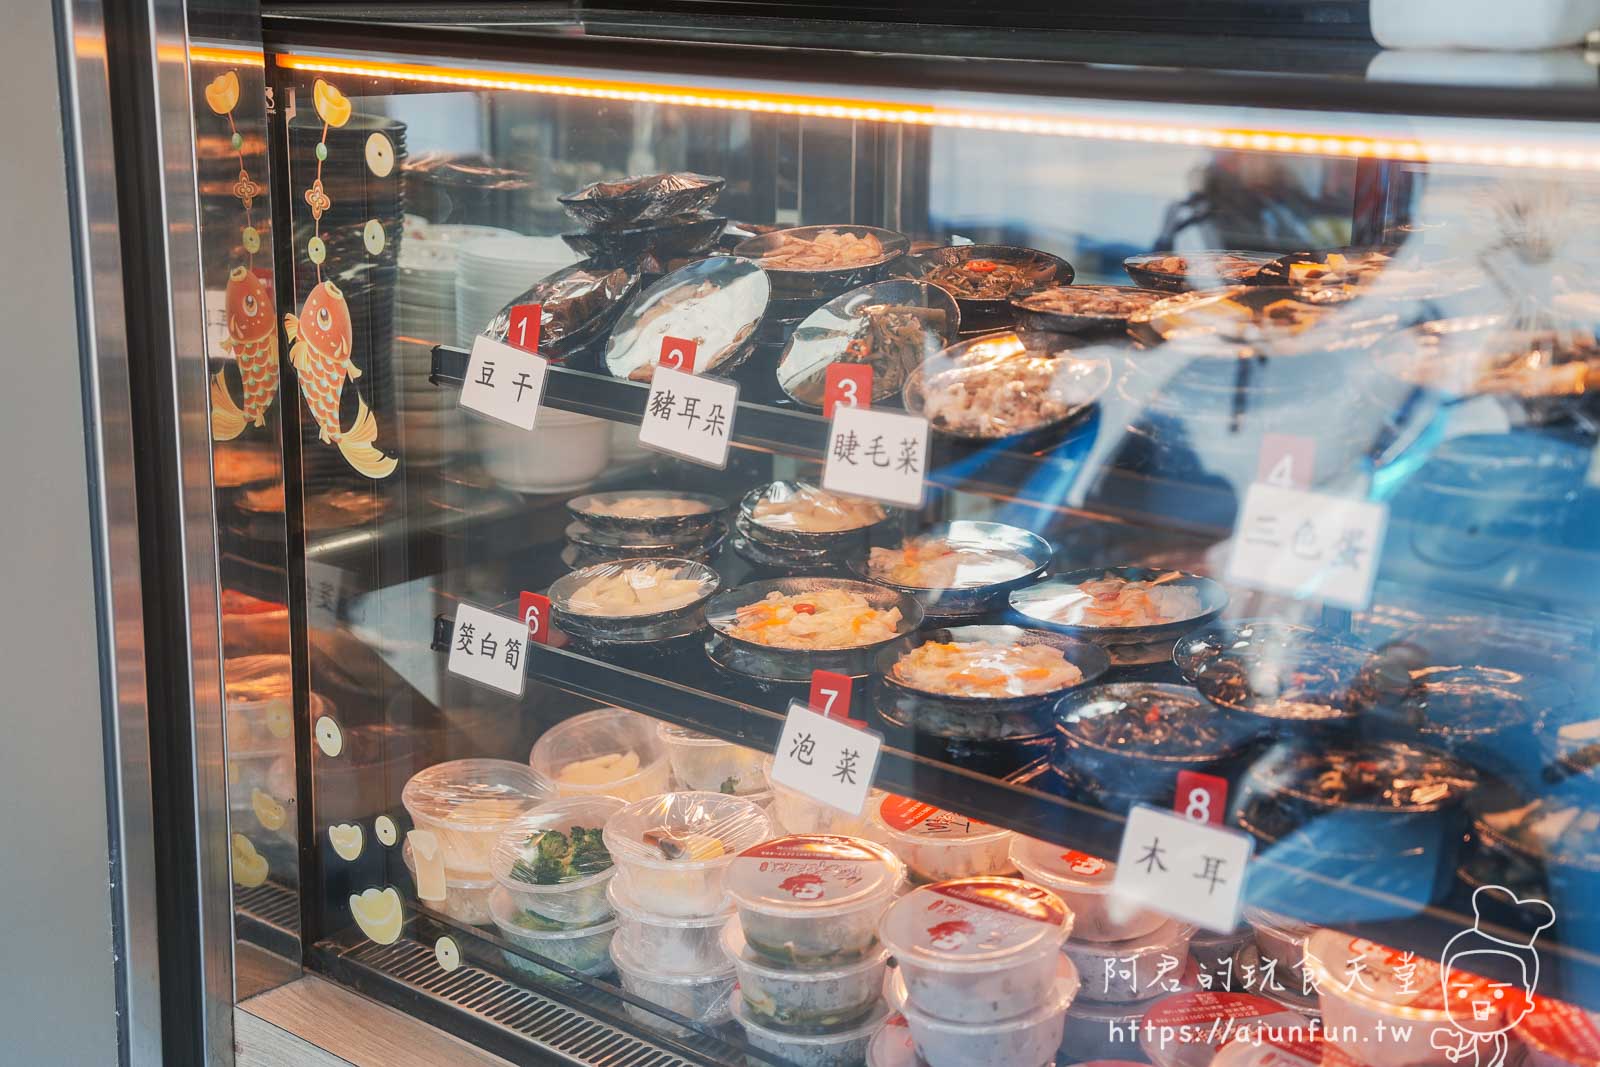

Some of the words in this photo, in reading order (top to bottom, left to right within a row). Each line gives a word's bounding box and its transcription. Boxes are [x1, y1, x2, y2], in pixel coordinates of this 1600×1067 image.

[517, 316, 528, 346] 1
[474, 360, 533, 402] 豆干
[836, 378, 858, 408] 3
[649, 389, 726, 436] 豬耳朵
[833, 429, 919, 475] 睫毛菜
[1266, 454, 1295, 487] 4
[525, 605, 540, 634] 6
[456, 622, 522, 671] 筊白筍
[820, 688, 839, 718] 7
[789, 732, 860, 785] 泡菜
[1185, 787, 1211, 824] 8
[1135, 836, 1227, 896] 木耳
